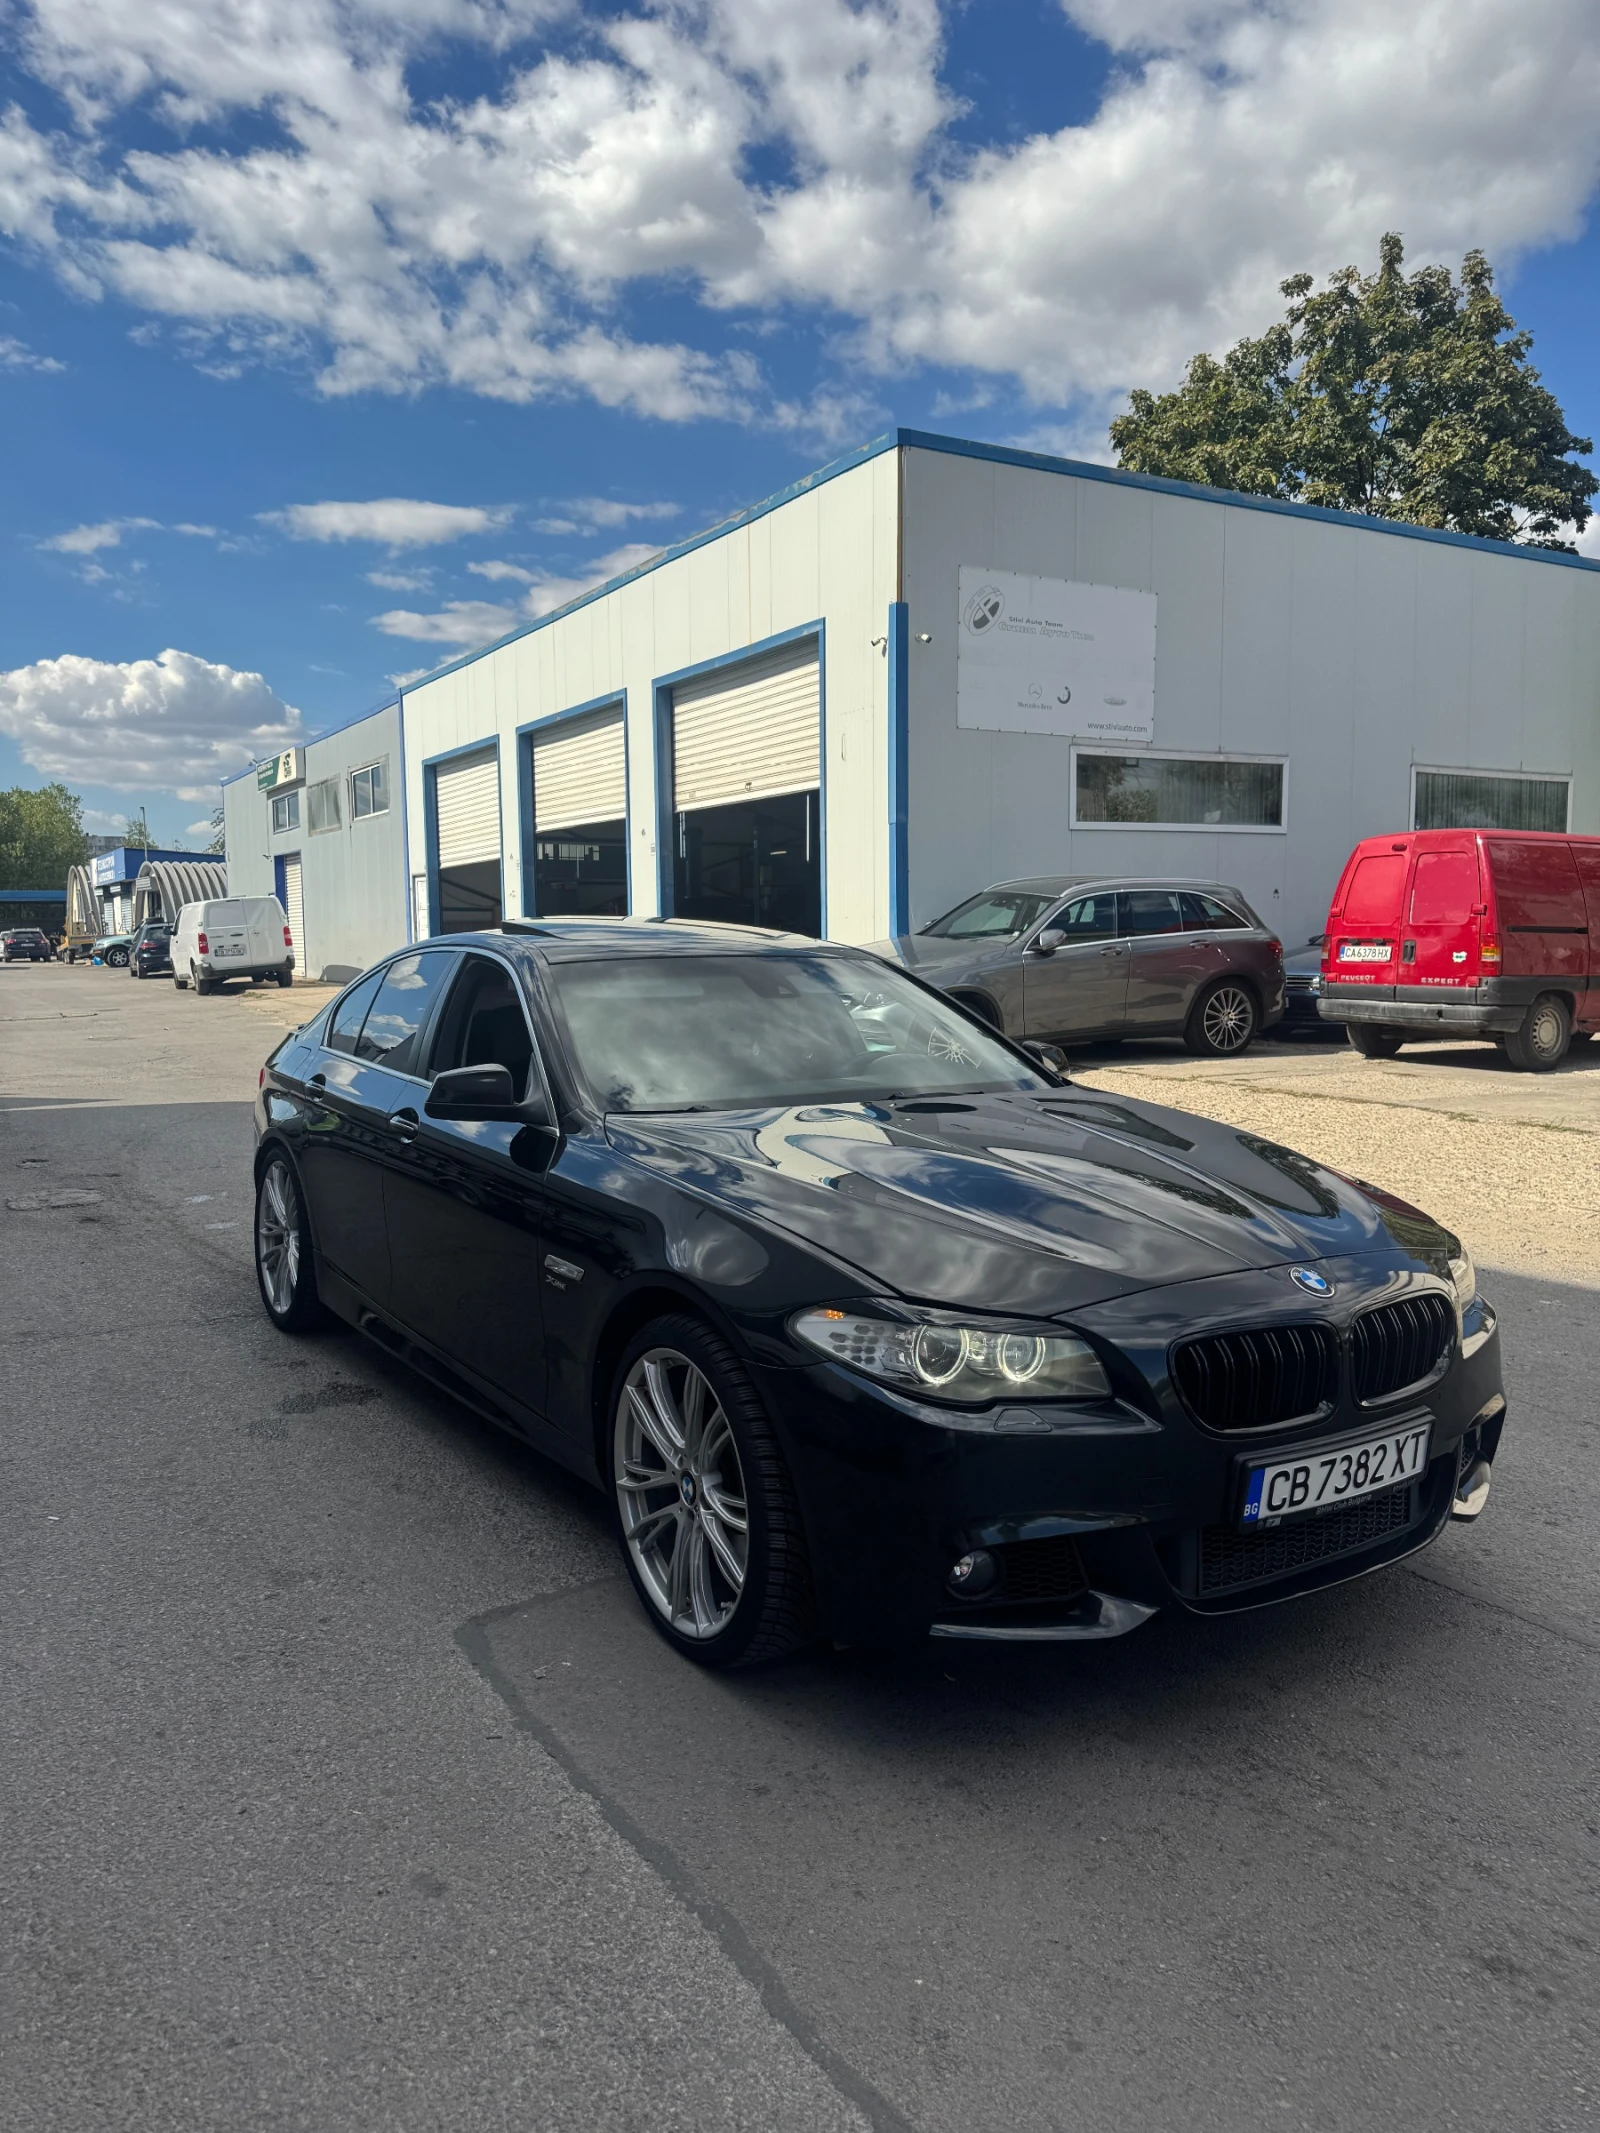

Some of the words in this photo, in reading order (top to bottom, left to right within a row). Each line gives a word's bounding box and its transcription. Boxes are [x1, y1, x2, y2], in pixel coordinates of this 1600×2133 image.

[1025, 618, 1043, 626] Auto
[1045, 620, 1063, 628] Team
[1420, 977, 1460, 985] EXPERT
[1243, 1502, 1259, 1517] BG
[1316, 1503, 1334, 1516] BMW
[1333, 1501, 1348, 1511] Club
[1348, 1494, 1372, 1506] Bulgaria
